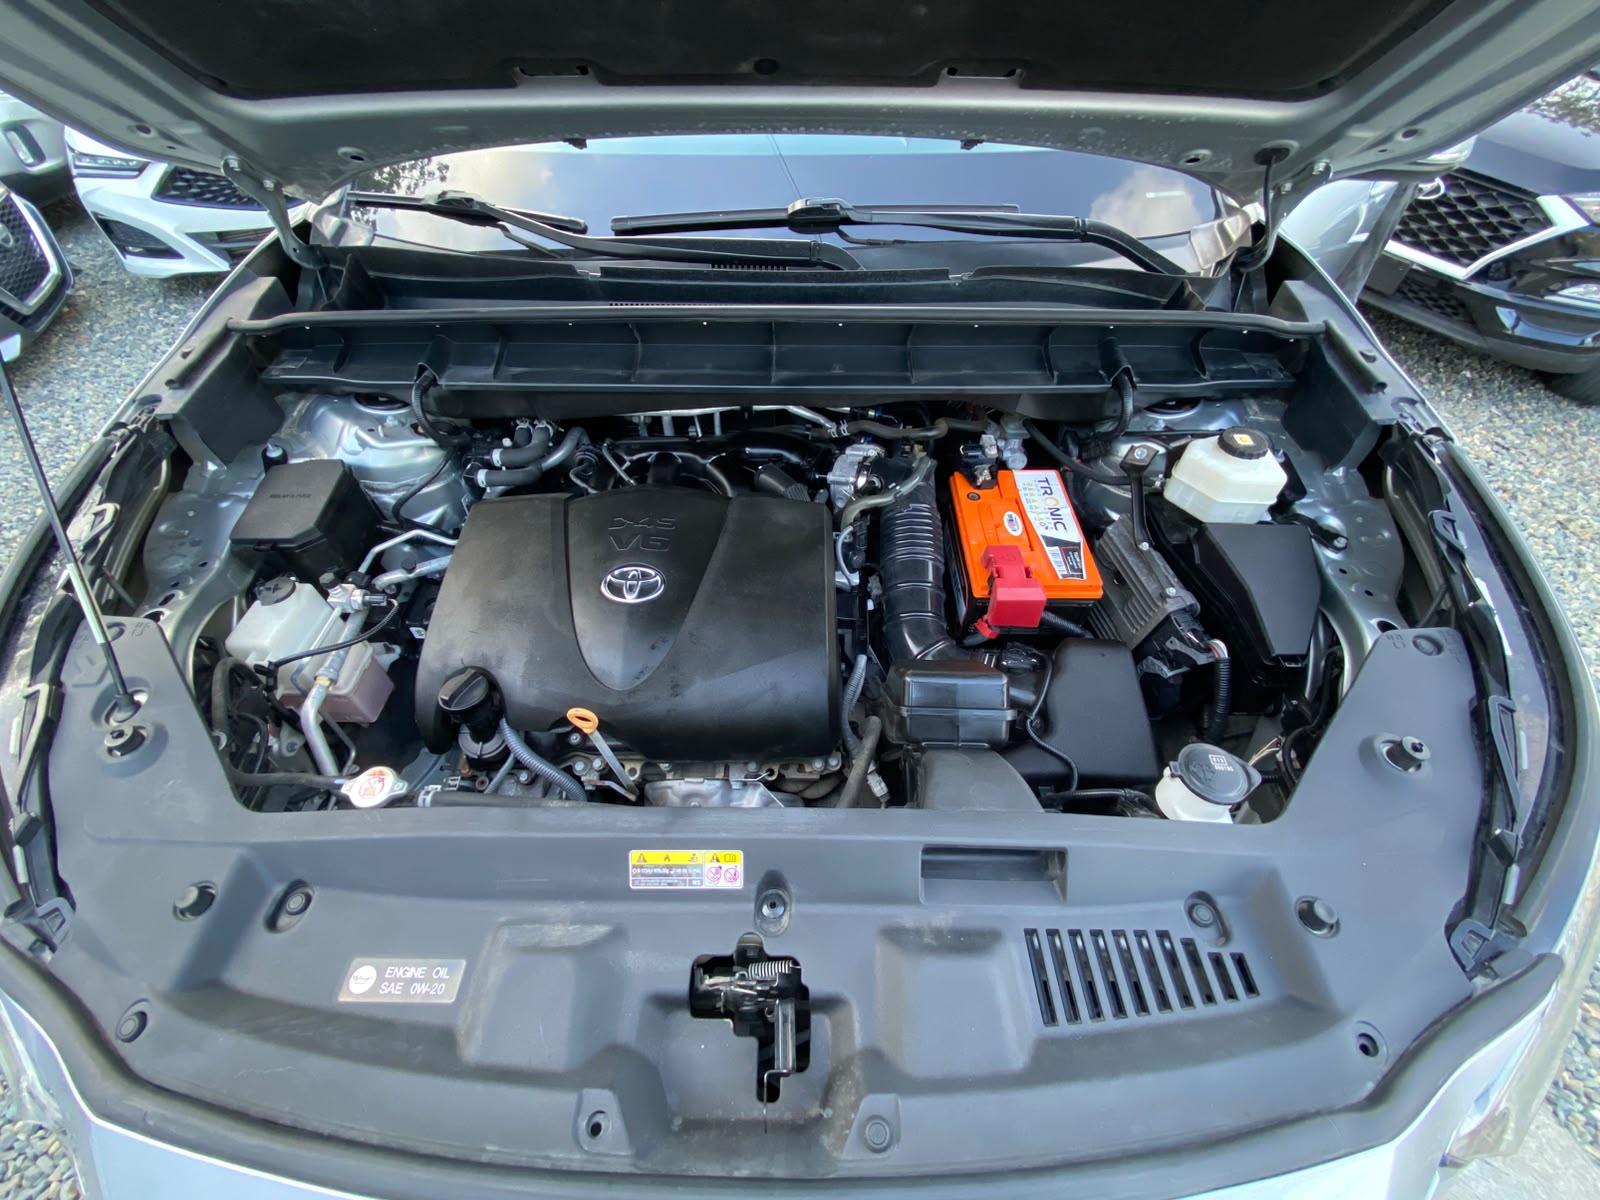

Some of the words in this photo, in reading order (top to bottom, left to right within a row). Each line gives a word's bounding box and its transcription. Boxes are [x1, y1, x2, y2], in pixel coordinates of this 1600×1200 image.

[1038, 477, 1067, 533] TRONIC
[608, 533, 672, 552] V6
[385, 966, 427, 979] ENGINE
[432, 966, 450, 979] OIL
[379, 982, 404, 995] SAE
[410, 982, 446, 995] 0W-20
